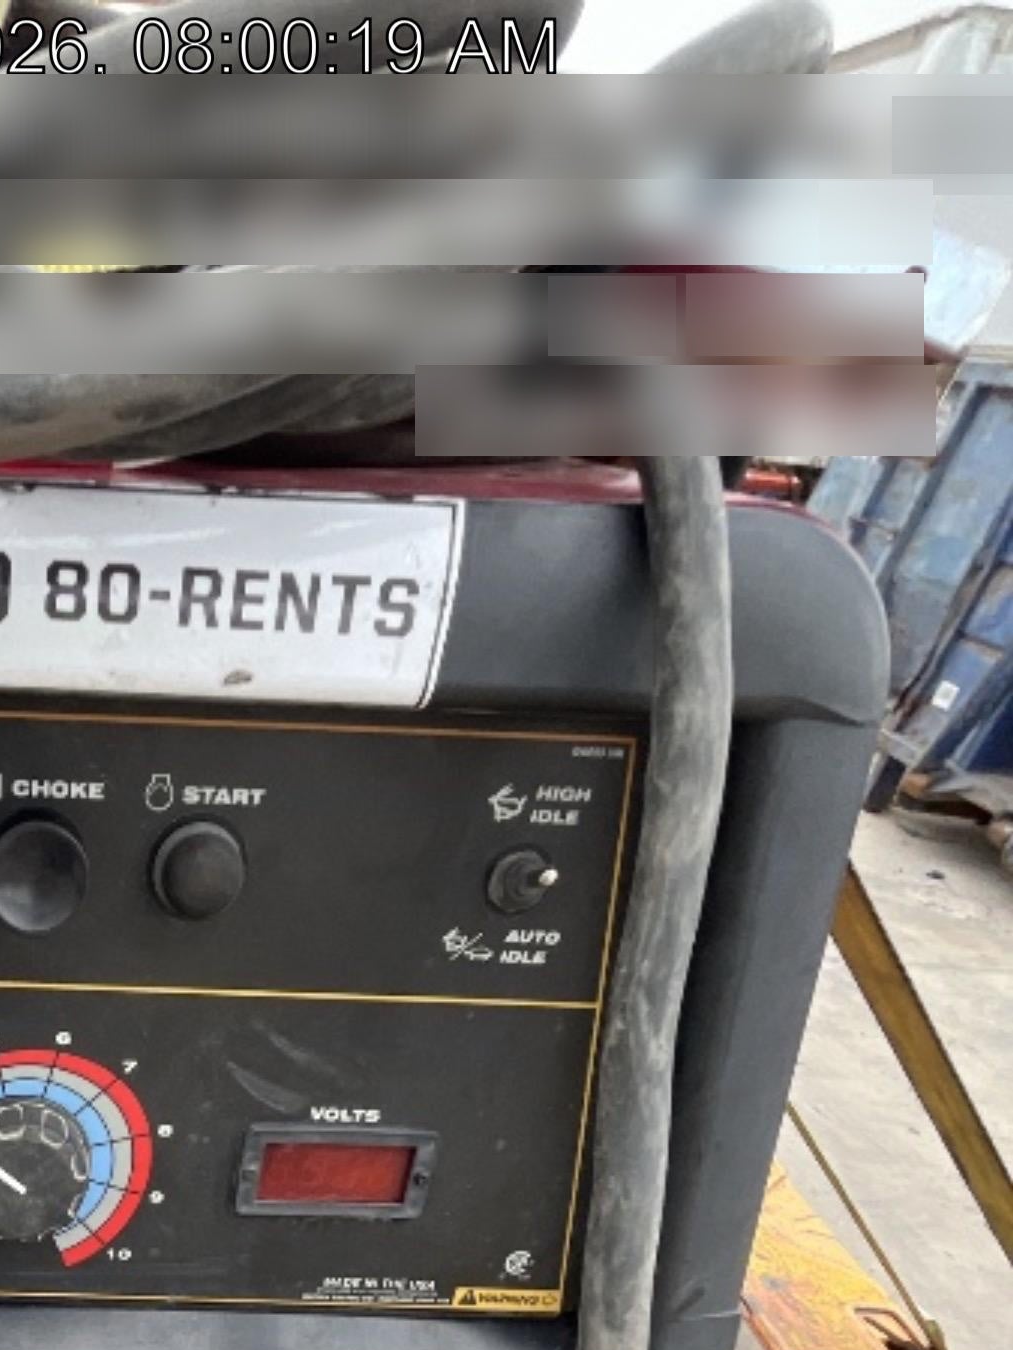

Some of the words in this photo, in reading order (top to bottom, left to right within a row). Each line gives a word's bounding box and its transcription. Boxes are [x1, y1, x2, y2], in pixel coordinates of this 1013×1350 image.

[43, 559, 422, 639] 80-RENTS
[12, 779, 106, 800] CHOKE
[182, 786, 267, 807] START
[535, 785, 592, 803] HIGH
[529, 809, 580, 826] IDLE
[503, 929, 562, 946] AUTO
[499, 950, 547, 965] IDLE
[55, 1031, 72, 1046] 6
[122, 1058, 138, 1074] 7
[309, 1106, 382, 1123] VOLTS
[149, 1190, 165, 1205] 9
[107, 1248, 132, 1261] 10
